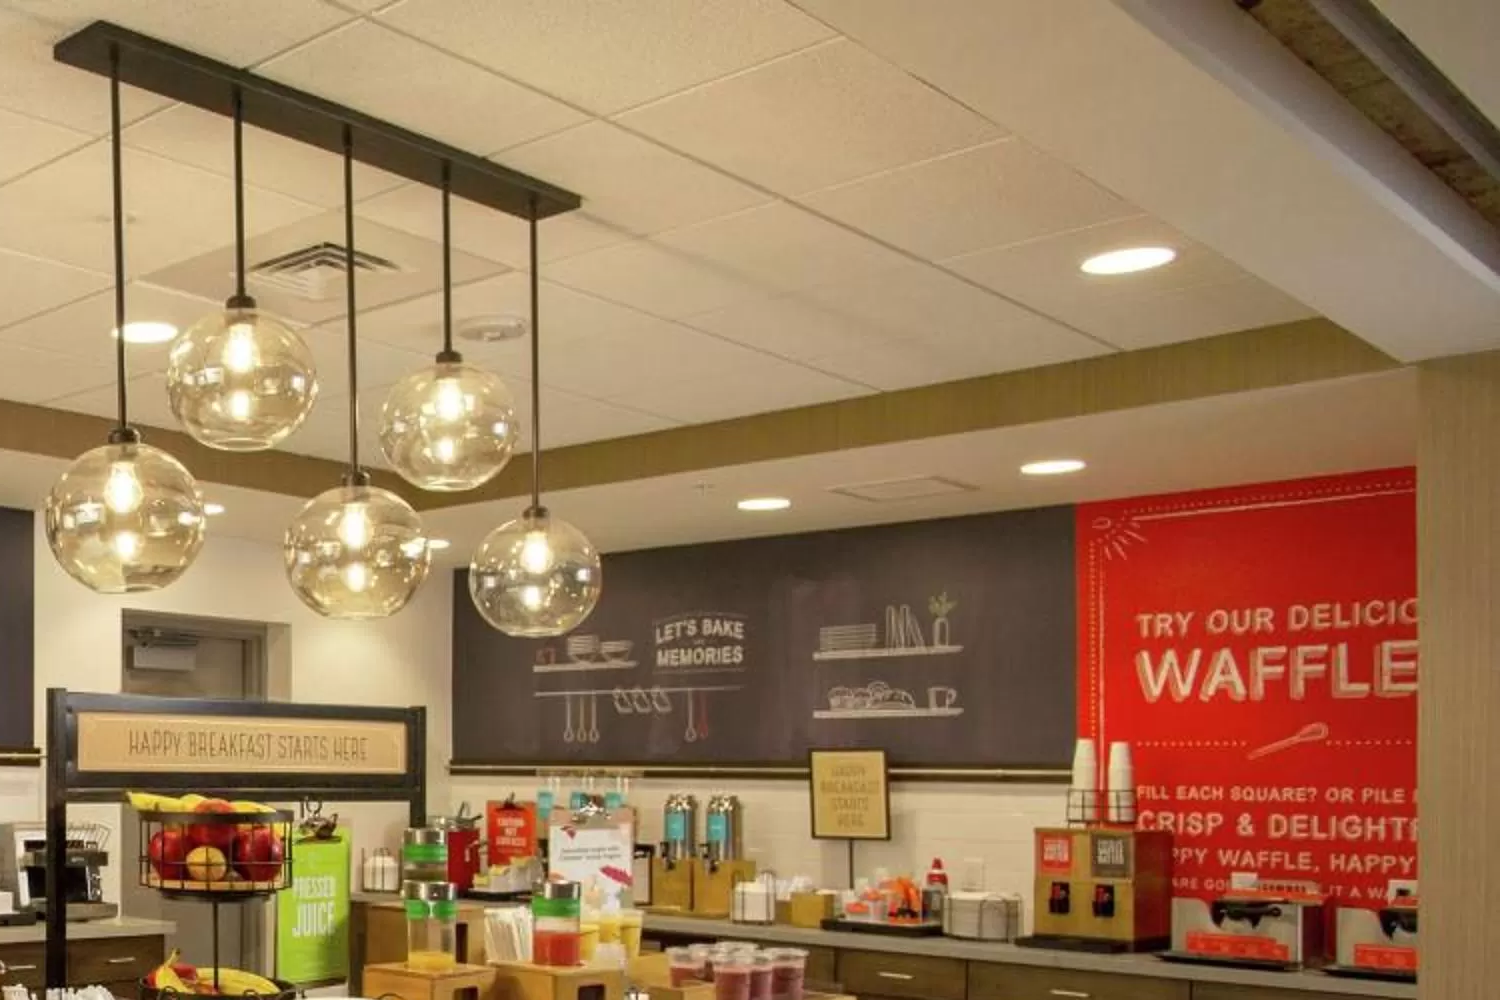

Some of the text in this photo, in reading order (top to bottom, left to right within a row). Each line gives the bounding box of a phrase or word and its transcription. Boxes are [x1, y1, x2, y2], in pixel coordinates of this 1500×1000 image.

[656, 618, 744, 644] LET'S BAKE
[1137, 612, 1194, 638] TRY
[1205, 607, 1275, 635] OUR
[657, 645, 744, 667] MEMORIES
[129, 728, 369, 762] HAPPY BREAKFAST STARTS HERE
[1137, 785, 1405, 804] FILL EACH SQUARE? OR PILE
[1136, 809, 1224, 837] CRISP
[1237, 812, 1255, 837] &
[1330, 853, 1415, 875] HAPPY
[291, 901, 337, 937] JUICE
